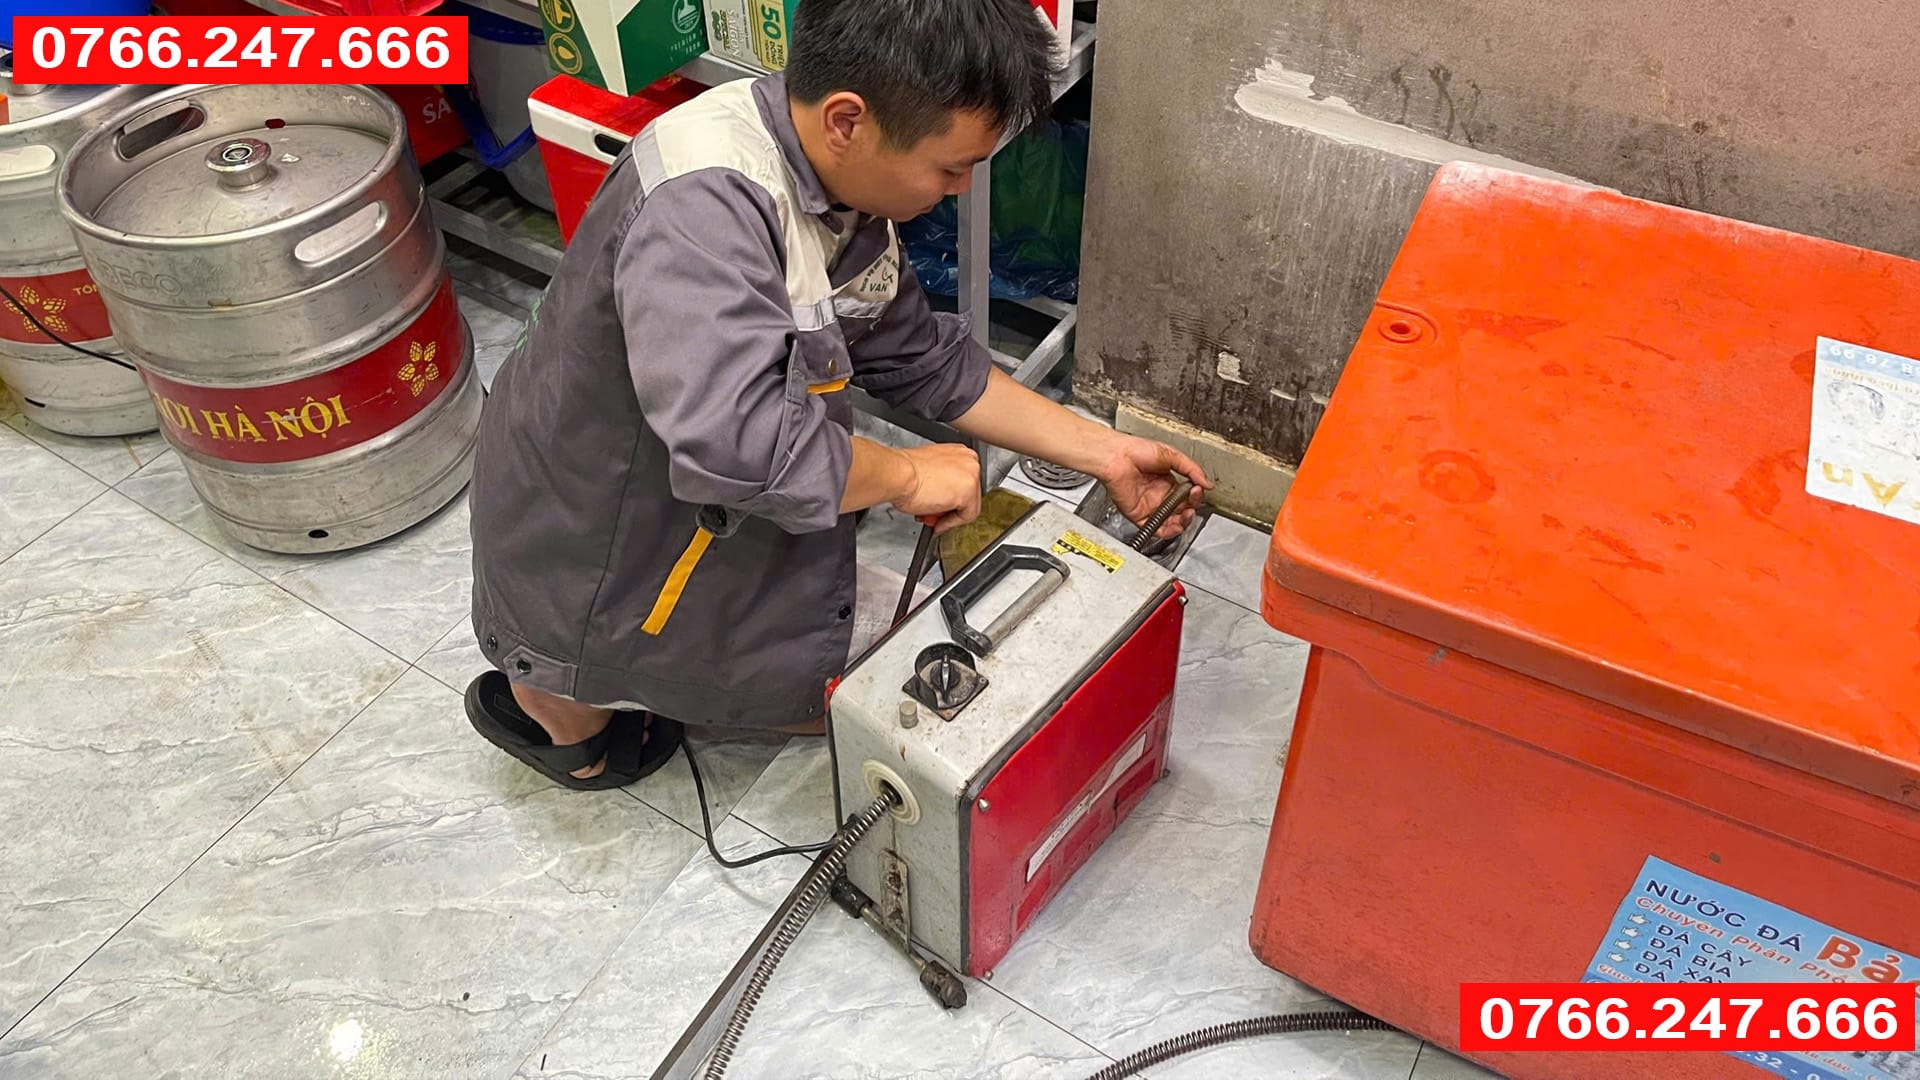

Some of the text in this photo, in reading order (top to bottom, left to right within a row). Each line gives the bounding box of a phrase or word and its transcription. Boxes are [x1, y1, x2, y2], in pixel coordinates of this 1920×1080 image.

[761, 4, 782, 40] 50
[201, 404, 266, 443] HÀ
[265, 394, 351, 441] NỘI
[1636, 896, 1725, 939] Chuyên
[1731, 935, 1792, 965] Phân
[1645, 879, 1746, 928] NƯỚC
[1756, 923, 1804, 952] ĐÁ
[1642, 950, 1674, 970] ĐÁ
[1649, 937, 1732, 978] ĐÁ BIA
[1656, 924, 1753, 967] ĐÁ CÂY
